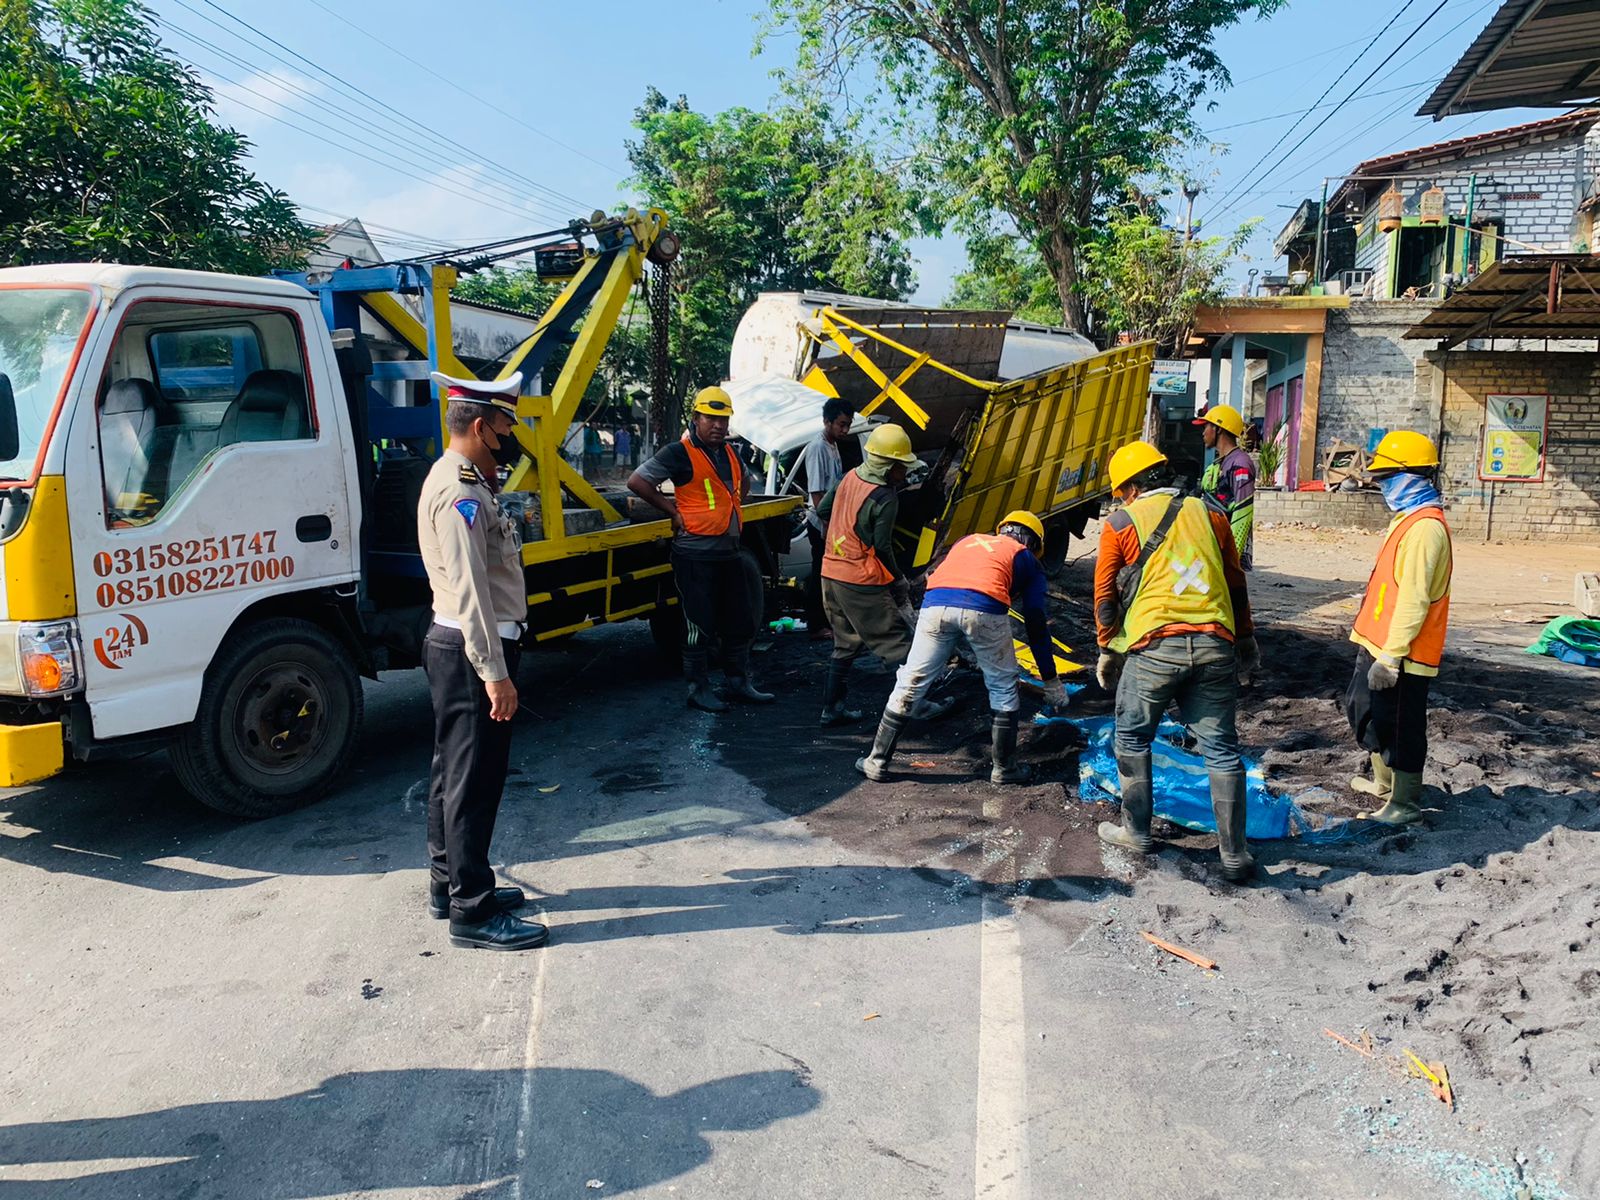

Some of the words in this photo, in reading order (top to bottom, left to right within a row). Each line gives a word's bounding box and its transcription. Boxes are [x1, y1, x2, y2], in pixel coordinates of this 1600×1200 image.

[93, 530, 277, 577] 03158251747
[96, 555, 295, 608] 085108227000
[105, 623, 136, 652] 24
[112, 649, 132, 662] JAM
